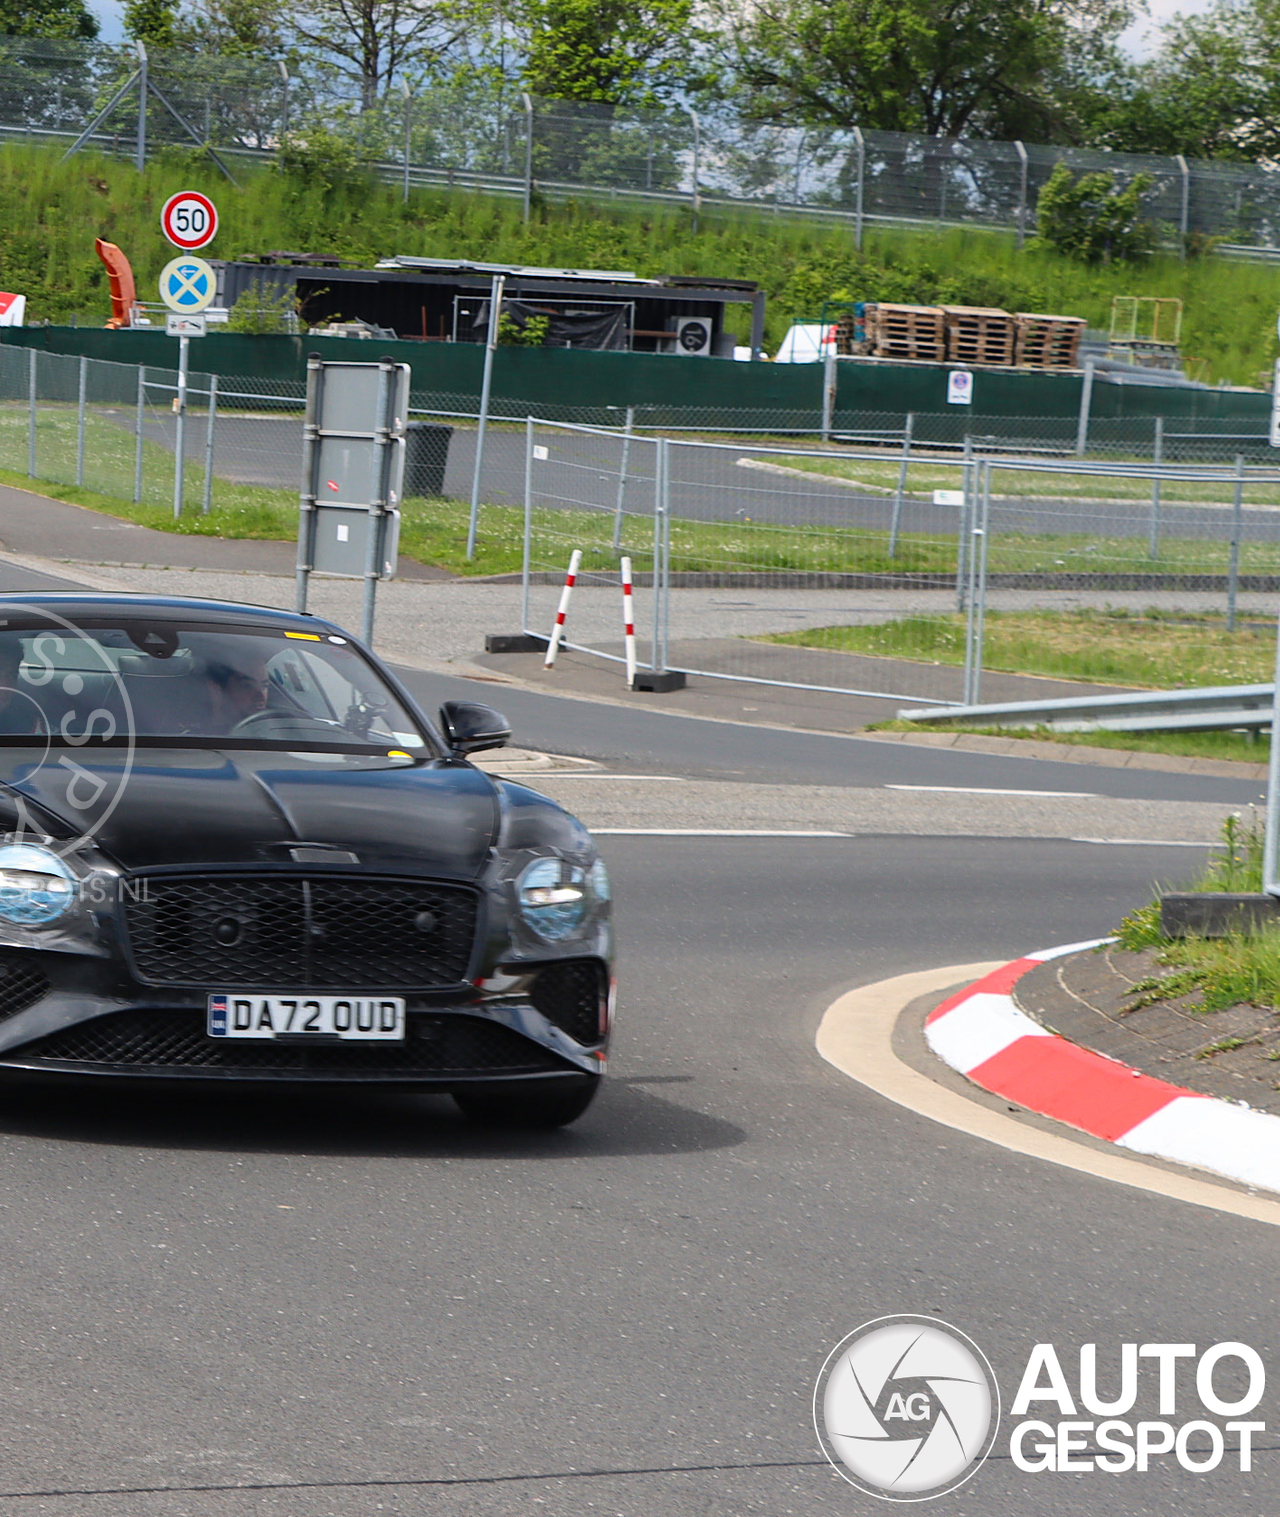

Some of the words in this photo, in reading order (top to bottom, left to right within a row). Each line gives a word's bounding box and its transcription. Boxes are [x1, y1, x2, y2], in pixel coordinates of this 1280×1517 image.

[176, 208, 205, 232] 50
[233, 999, 321, 1031] DA72
[333, 1000, 397, 1032] OUD
